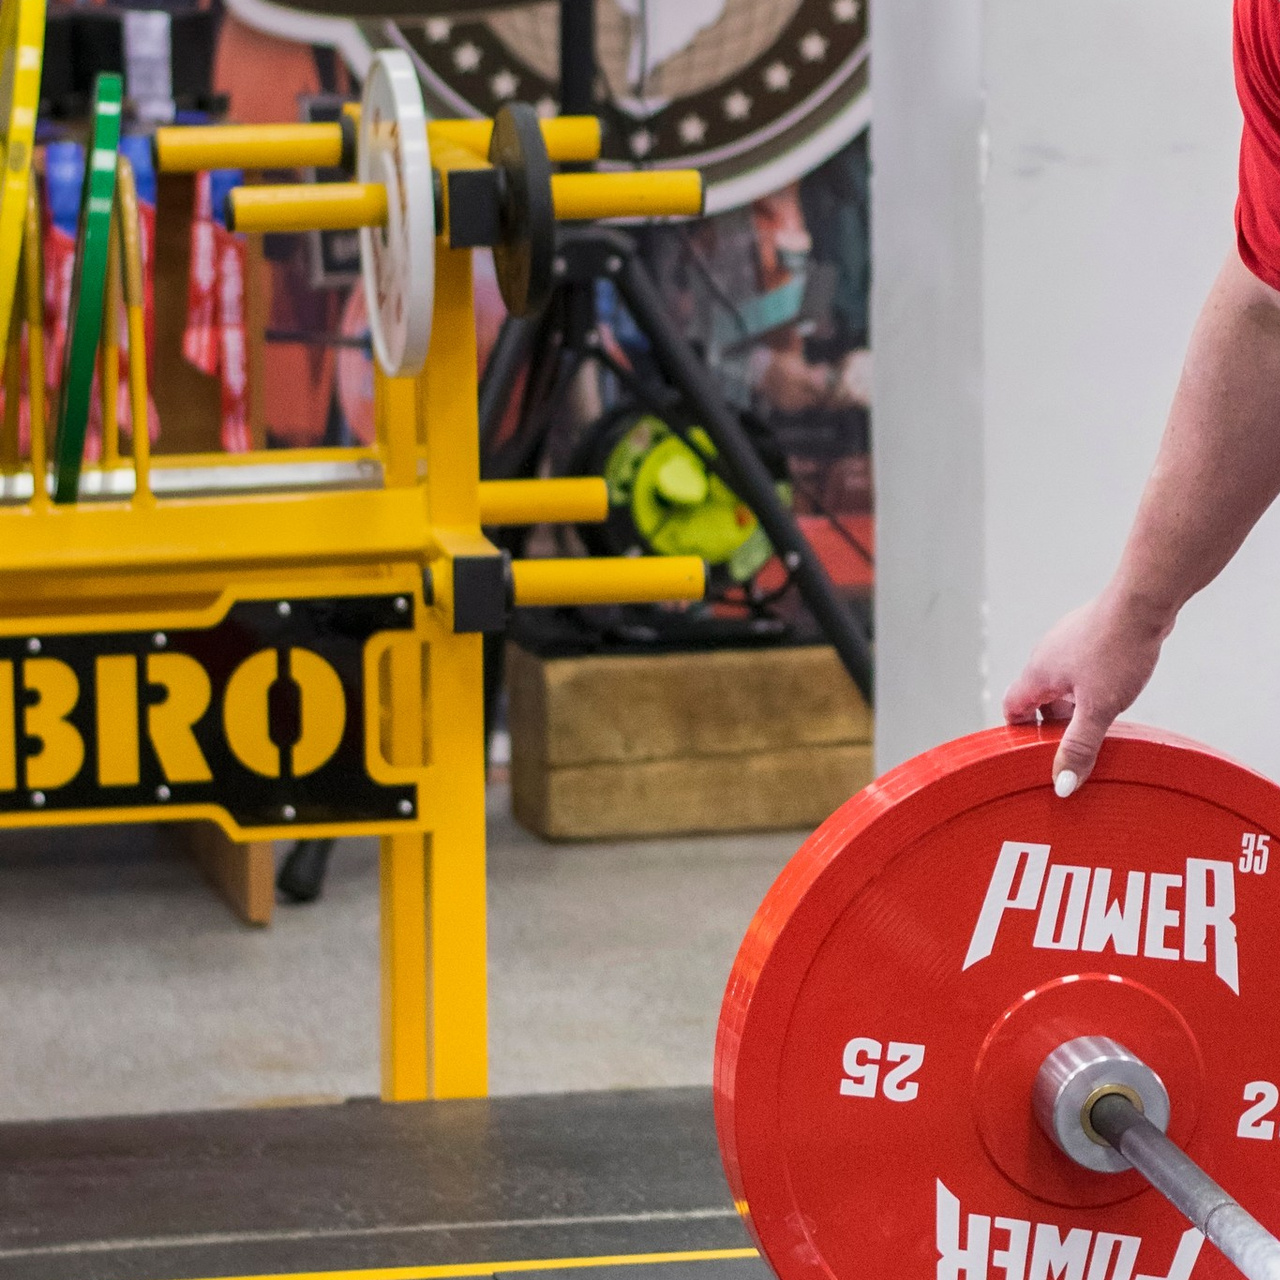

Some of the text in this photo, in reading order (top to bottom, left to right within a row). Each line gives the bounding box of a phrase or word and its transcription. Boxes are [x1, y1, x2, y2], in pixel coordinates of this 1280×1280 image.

[962, 832, 1271, 997] POWER 35
[839, 1037, 926, 1103] 25
